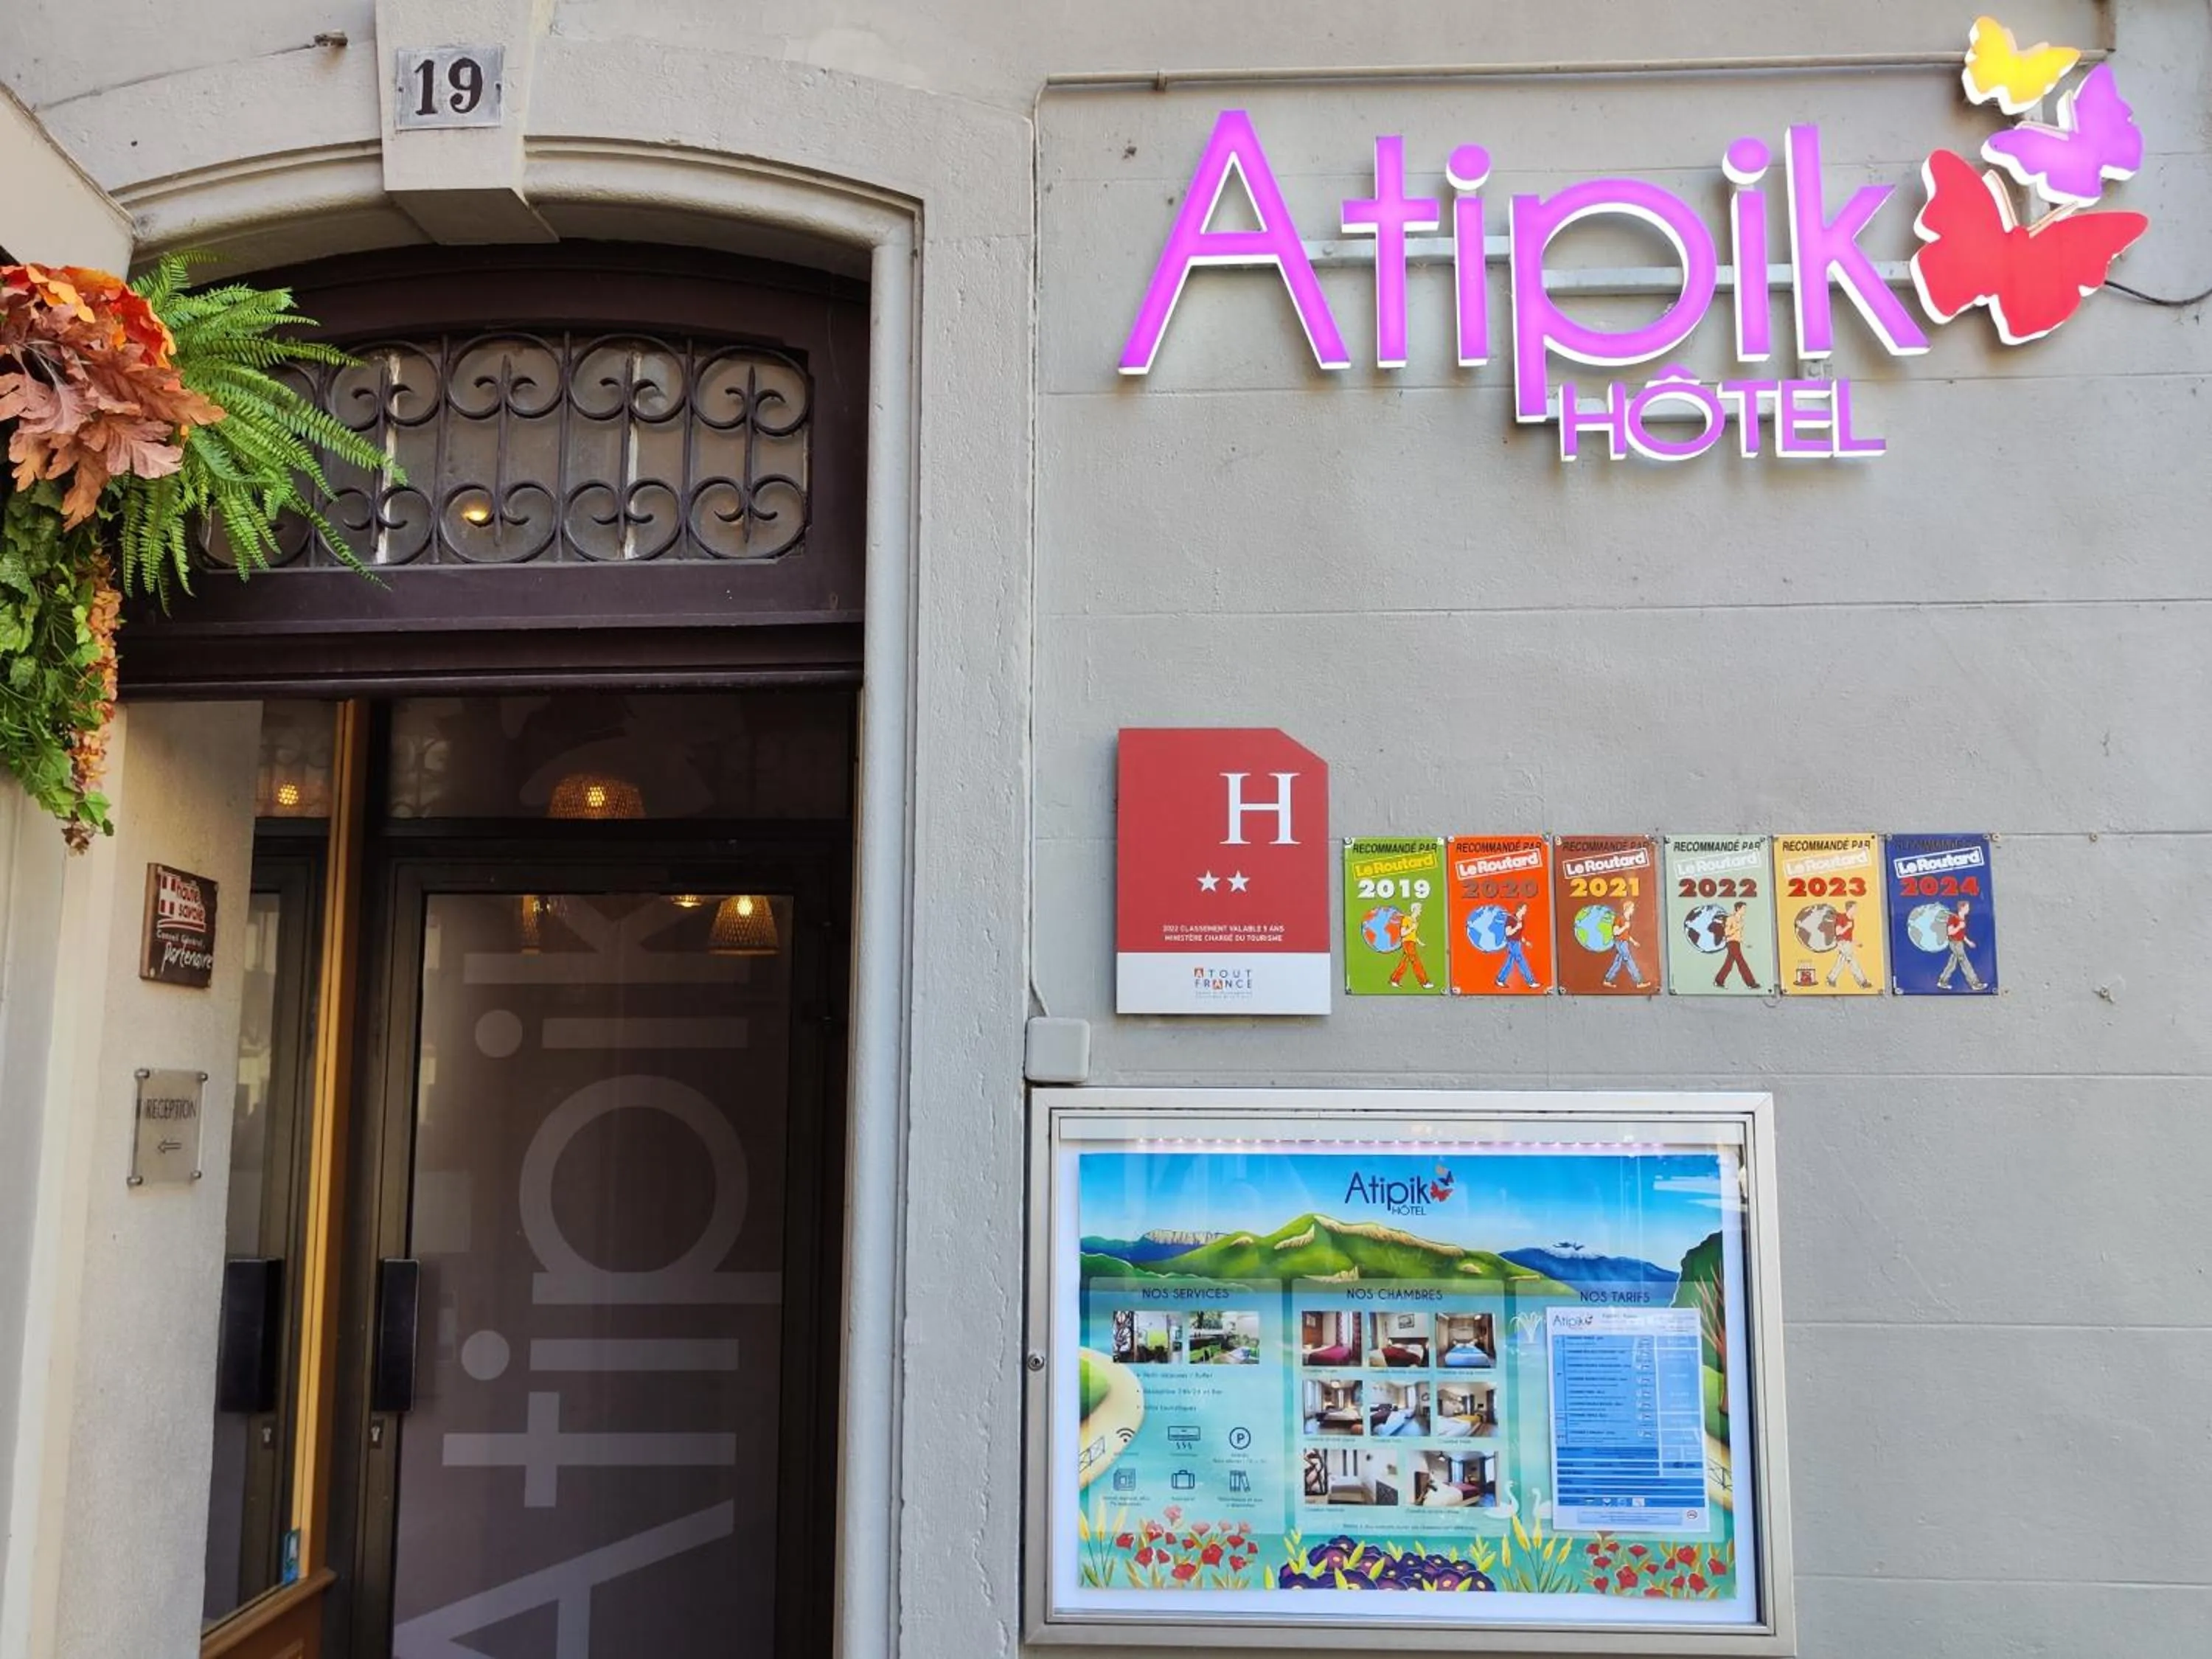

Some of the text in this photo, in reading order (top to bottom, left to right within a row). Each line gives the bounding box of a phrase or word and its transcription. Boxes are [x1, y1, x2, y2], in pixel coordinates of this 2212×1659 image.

[414, 57, 483, 115] 19
[1118, 110, 1930, 423] Atipik
[1558, 366, 1887, 462] HÔTEL
[1220, 773, 1301, 844] H
[1352, 841, 1416, 854] RECOMMANDÉ
[1456, 841, 1520, 853] RECOMMANDÉ
[1674, 838, 1739, 852] RECOMMANDÉ
[1783, 838, 1848, 852] RECOMMANDÉ
[1373, 854, 1433, 873] Routard
[1476, 853, 1538, 873] Routard
[1585, 852, 1646, 872] Routard
[1697, 851, 1757, 872] Routard
[1806, 850, 1868, 872] Routard
[1917, 850, 1980, 871] Routard
[1357, 879, 1430, 899] 2019
[1462, 881, 1538, 899] 2020
[1569, 877, 1639, 897] 2021
[1679, 878, 1757, 897] 2022
[1788, 877, 1867, 897] 2023
[1900, 876, 1979, 897] 2024
[1180, 925, 1227, 933] CLASSEMENT
[1230, 925, 1261, 933] VALABLE
[1194, 979, 1252, 990] FRANCE
[1344, 1171, 1430, 1211] Atipik
[1392, 1205, 1427, 1216] HÔTEL
[1142, 1288, 1229, 1298] NOS SERVICES
[1346, 1288, 1443, 1300] NOS CHAMBRES
[1580, 1291, 1650, 1303] NOS TARIFS
